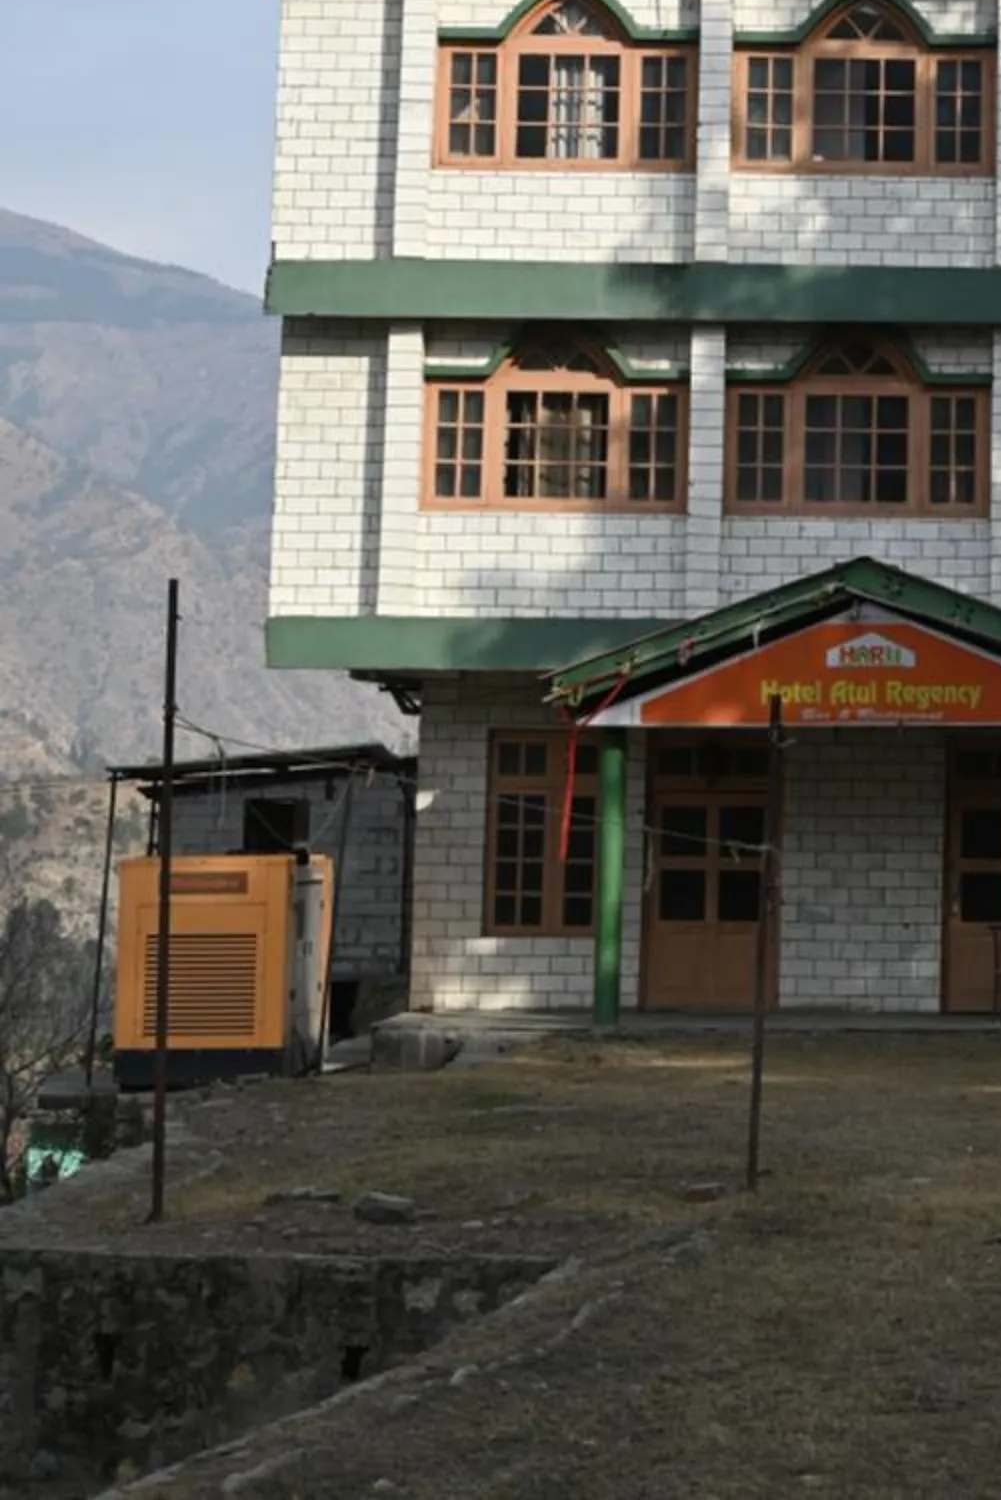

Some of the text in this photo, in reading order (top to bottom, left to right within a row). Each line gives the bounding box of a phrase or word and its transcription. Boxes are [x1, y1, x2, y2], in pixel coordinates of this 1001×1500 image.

[761, 679, 982, 709] Hotel Atul Regency
